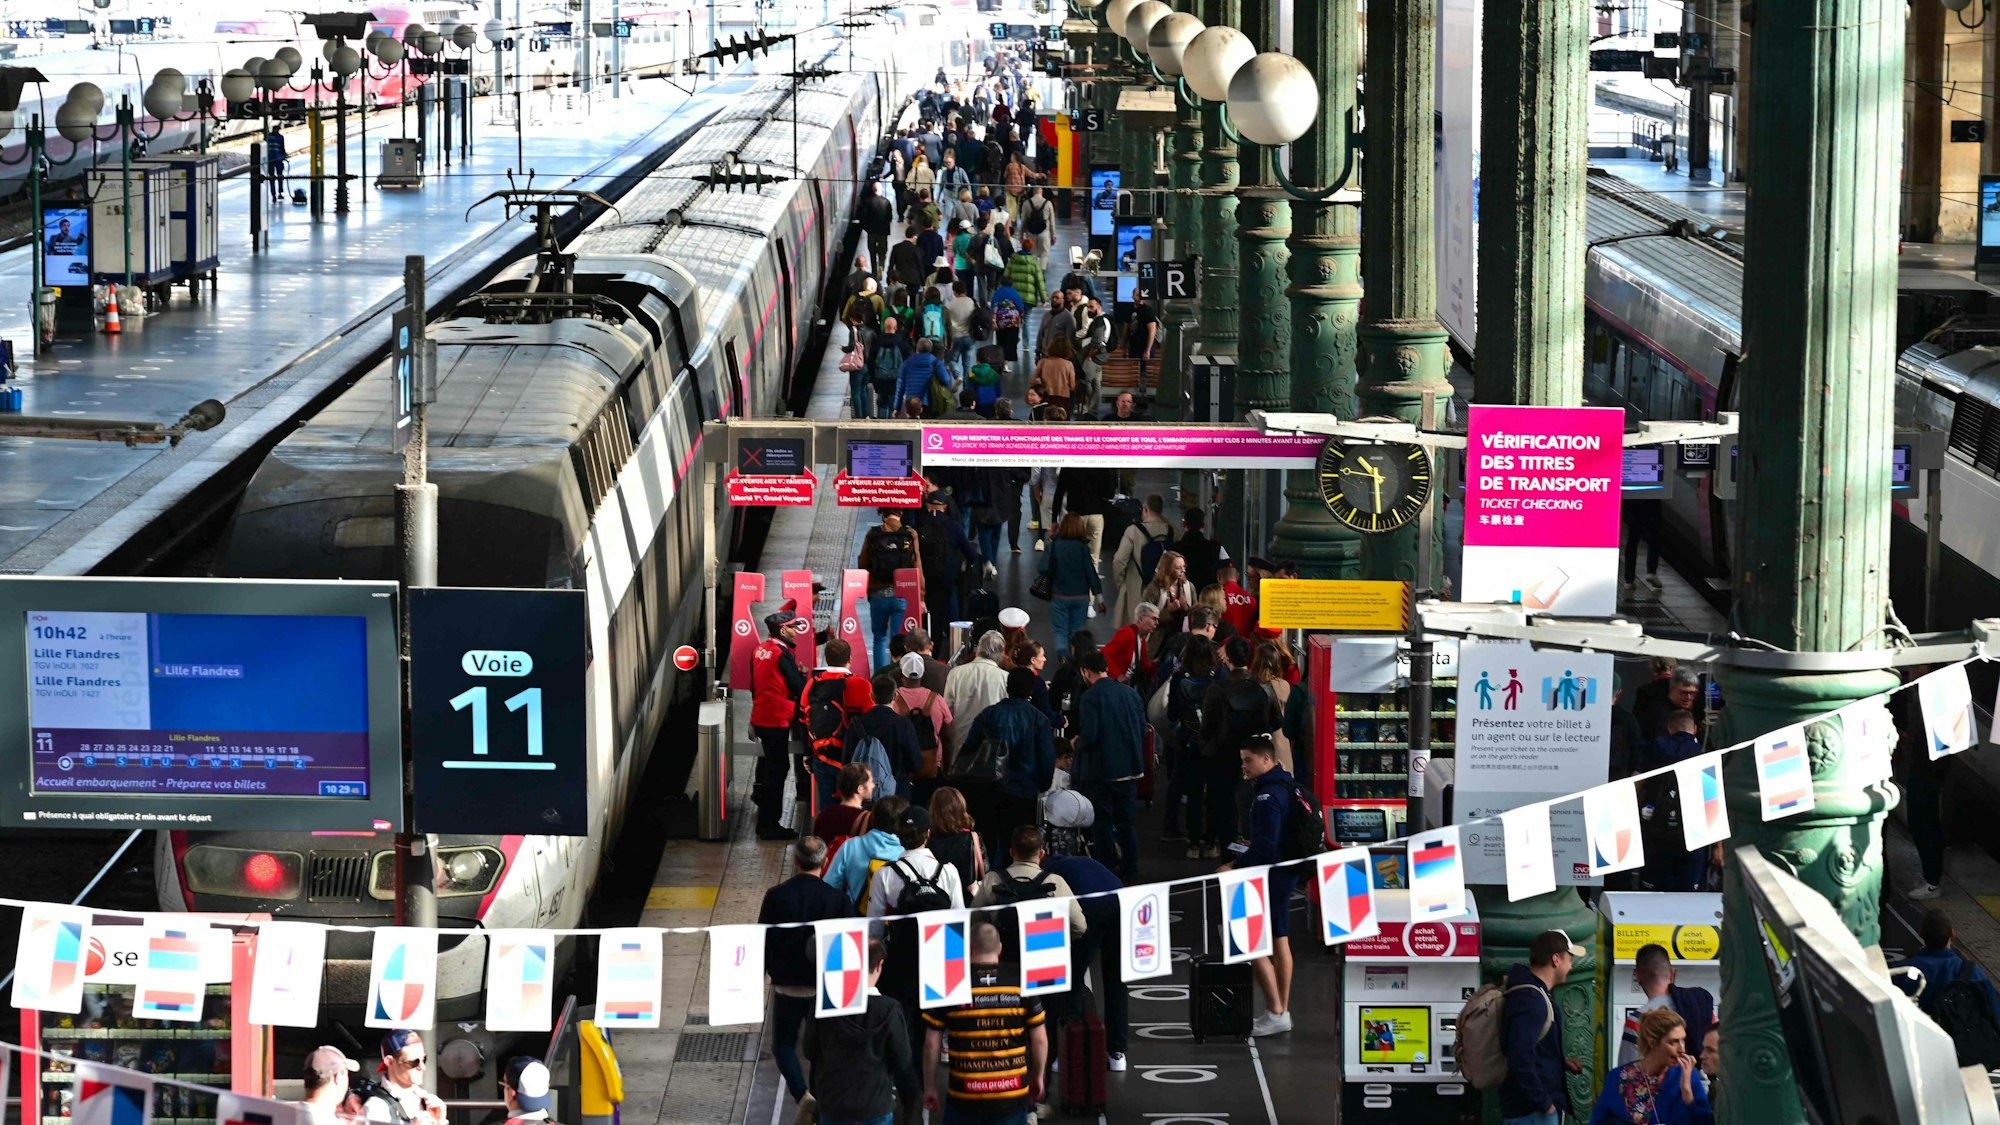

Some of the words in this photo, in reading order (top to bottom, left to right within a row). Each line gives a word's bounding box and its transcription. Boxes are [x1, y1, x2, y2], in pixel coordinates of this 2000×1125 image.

[616, 25, 628, 35] 10
[993, 28, 1004, 38] 11
[1048, 30, 1060, 38] 11
[448, 62, 457, 73] T
[243, 103, 254, 119] S
[1087, 114, 1098, 130] S
[1968, 126, 1978, 142] S
[1142, 268, 1153, 278] 11
[1166, 270, 1187, 296] R
[398, 354, 410, 416] 11
[1480, 432, 1600, 450] VÉRIFICATION
[1480, 456, 1514, 470] DES
[1518, 456, 1575, 470] TITRES
[1480, 476, 1504, 490] DE
[1508, 477, 1611, 492] TRANSPORT
[1480, 498, 1520, 509] TICKET
[1522, 498, 1583, 510] CHECKING
[34, 626, 87, 640] 10h42
[34, 648, 62, 658] Lille
[65, 649, 120, 660] Flandres
[471, 654, 522, 673] Voie
[165, 666, 189, 676] Lille
[192, 666, 240, 677] Flandres
[35, 676, 63, 686] Lille
[66, 676, 121, 687] Flandres
[449, 686, 544, 756] 11
[1472, 718, 1524, 728] Présentez
[1556, 720, 1582, 729] billet
[1585, 720, 1591, 729] à
[36, 738, 53, 750] 11
[1487, 733, 1515, 743] agent
[1553, 733, 1561, 742] le
[1565, 733, 1600, 742] lecteur
[36, 776, 74, 787] Accueil
[76, 778, 156, 788] embarquement
[166, 778, 212, 789] Préparez
[234, 780, 266, 789] billets
[326, 785, 337, 794] 10
[338, 786, 350, 794] 29
[38, 811, 71, 820] Présence
[72, 812, 76, 820] à
[78, 812, 94, 821] quai
[95, 812, 134, 821] obligatoire
[142, 812, 156, 821] min
[187, 814, 212, 823] départ
[1415, 942, 1444, 951] échange
[976, 1018, 1005, 1027] TRIPLE
[970, 1038, 1009, 1048] COUNTY
[955, 1058, 1010, 1070] CHAMPIONS
[967, 1080, 987, 1089] eden
[989, 1078, 1018, 1091] project
